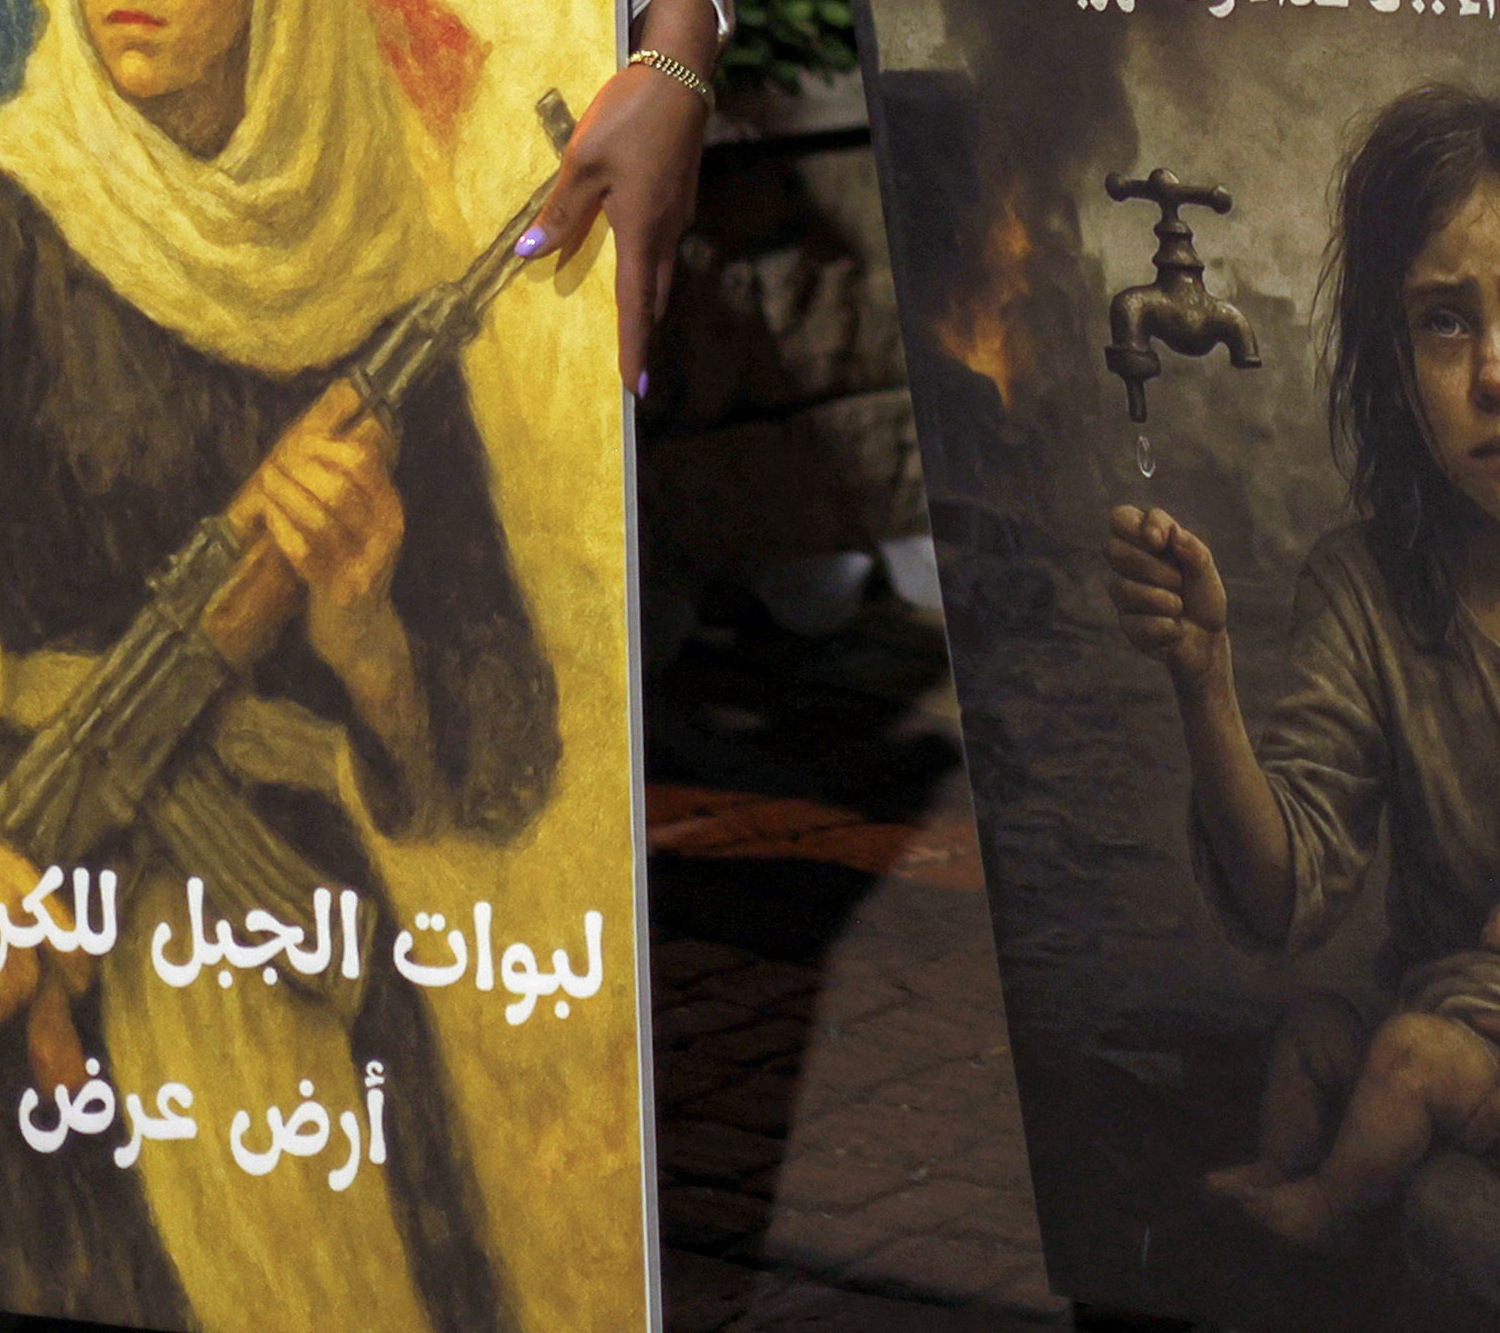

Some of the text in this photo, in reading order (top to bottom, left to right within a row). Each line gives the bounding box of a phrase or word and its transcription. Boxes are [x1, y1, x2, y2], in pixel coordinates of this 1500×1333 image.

[150, 876, 361, 990] الجبل
[393, 900, 604, 1027] لبوات
[18, 1057, 199, 1169] عرض
[229, 1059, 387, 1192] أرض
